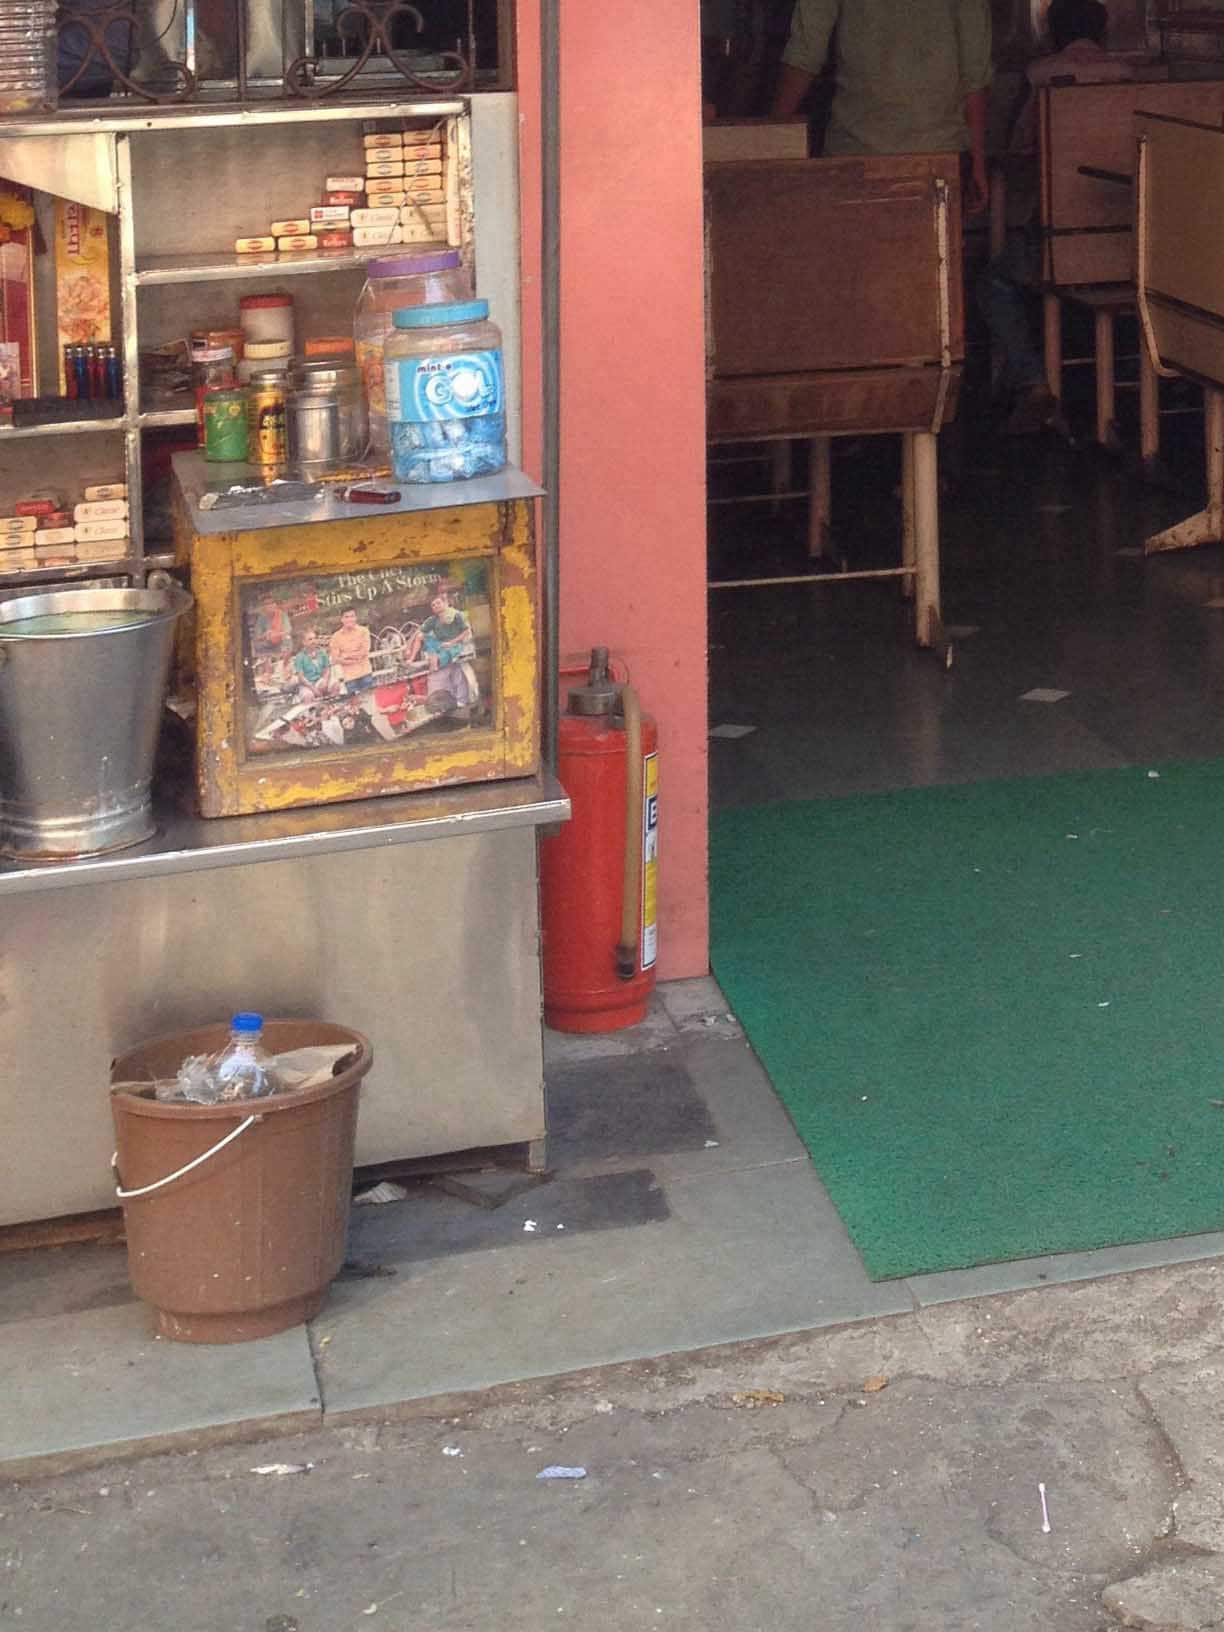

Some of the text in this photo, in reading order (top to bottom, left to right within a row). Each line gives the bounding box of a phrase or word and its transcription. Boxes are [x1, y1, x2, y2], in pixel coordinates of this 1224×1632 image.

[316, 573, 441, 608] Stirs Up A Storm
[337, 572, 366, 588] The
